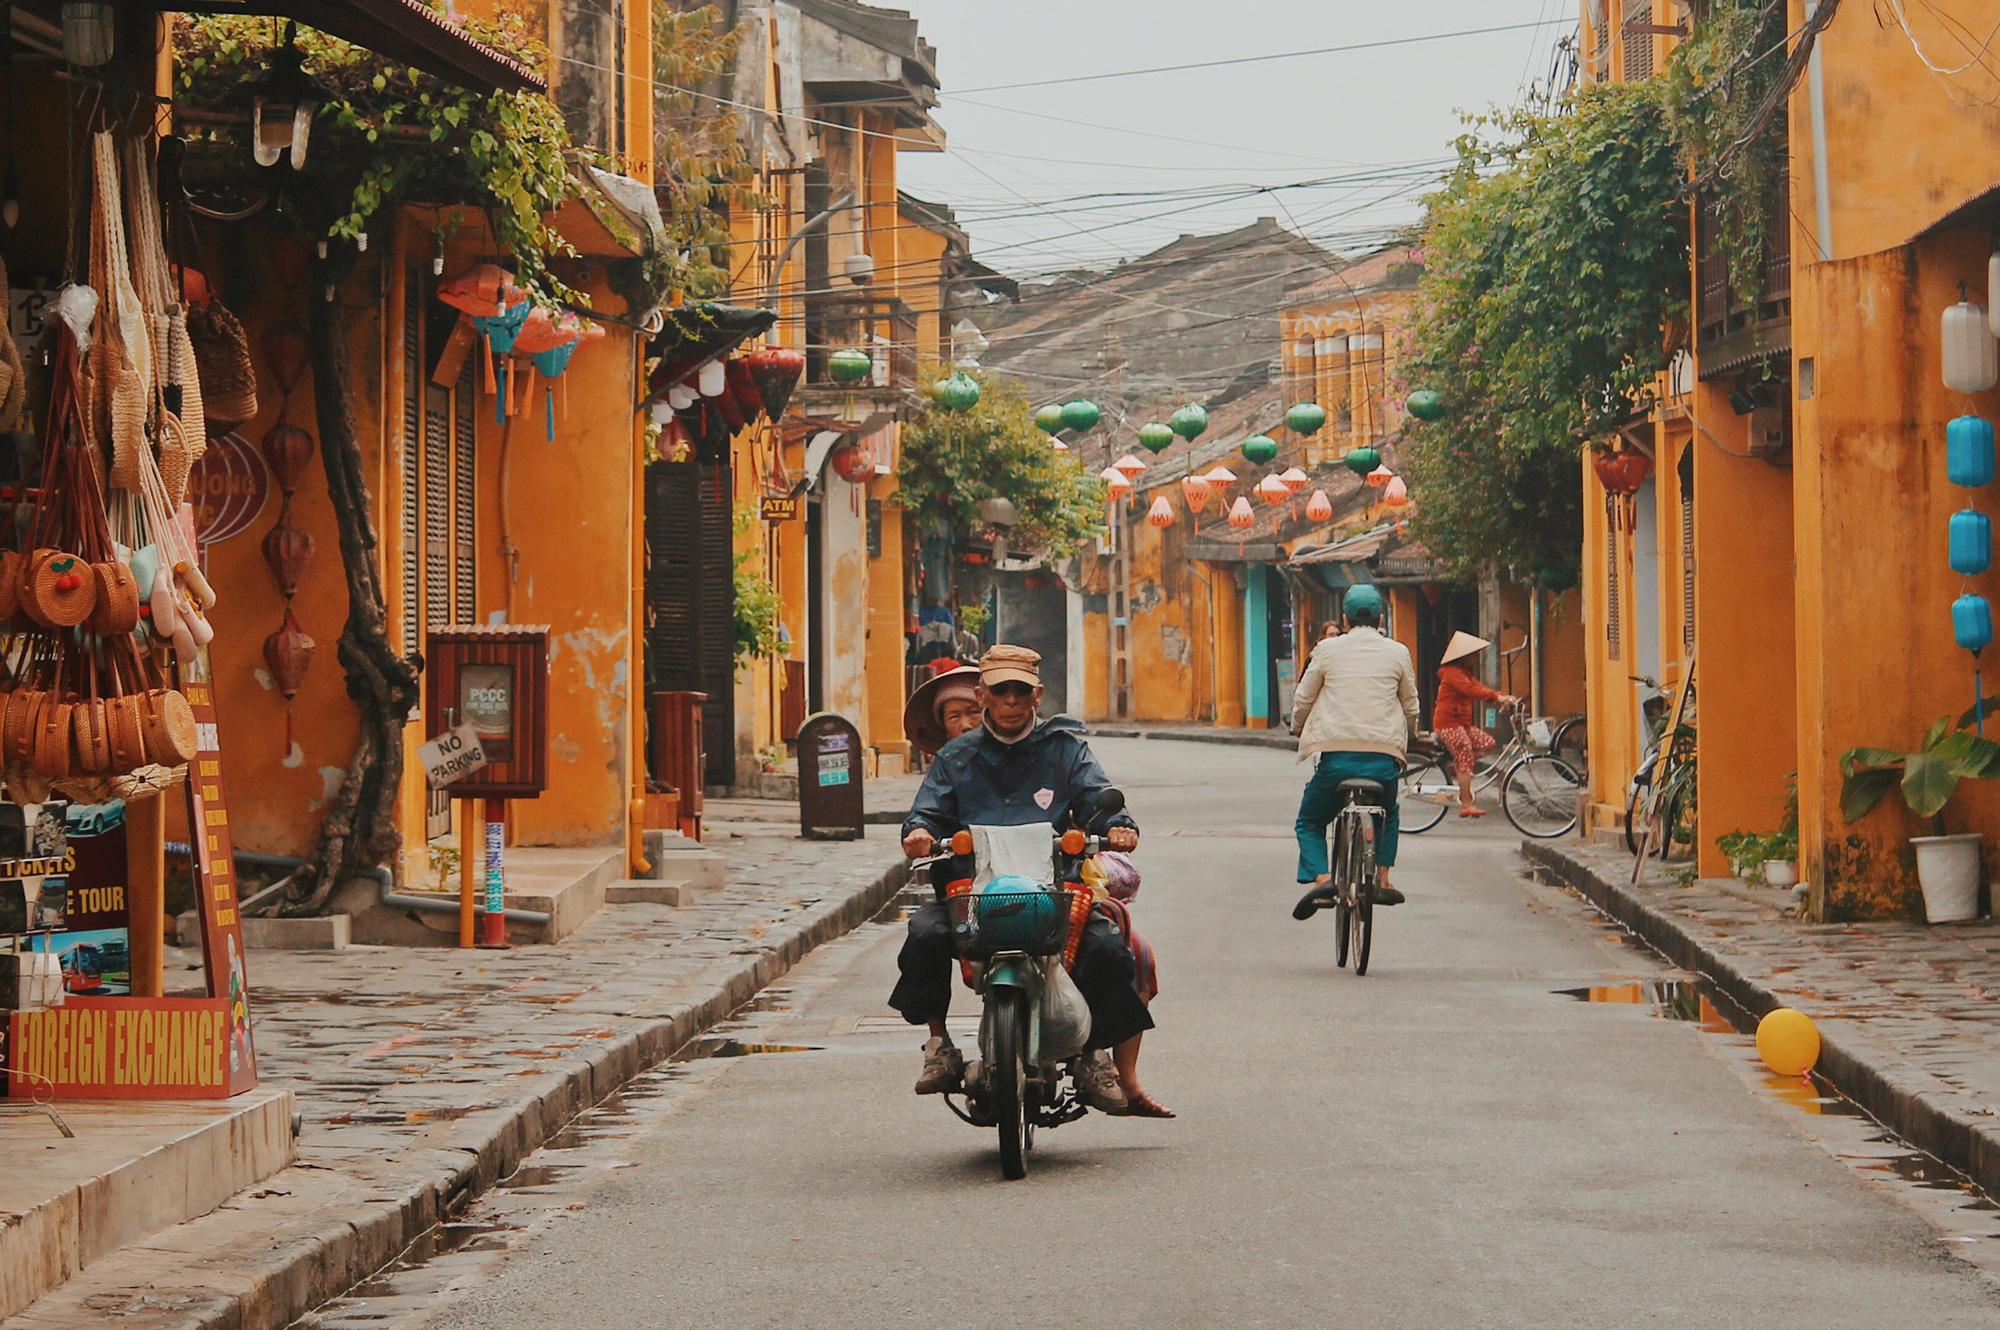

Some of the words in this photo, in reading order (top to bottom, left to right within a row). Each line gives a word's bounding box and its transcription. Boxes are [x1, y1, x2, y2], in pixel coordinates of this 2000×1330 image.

[762, 500, 795, 511] ATM
[470, 688, 506, 702] PCCC
[437, 735, 462, 756] NO
[431, 746, 482, 785] PARKING
[79, 886, 125, 914] TOUR
[16, 1008, 107, 1085] FOREIGN
[113, 1009, 225, 1086] EXCHANGE
